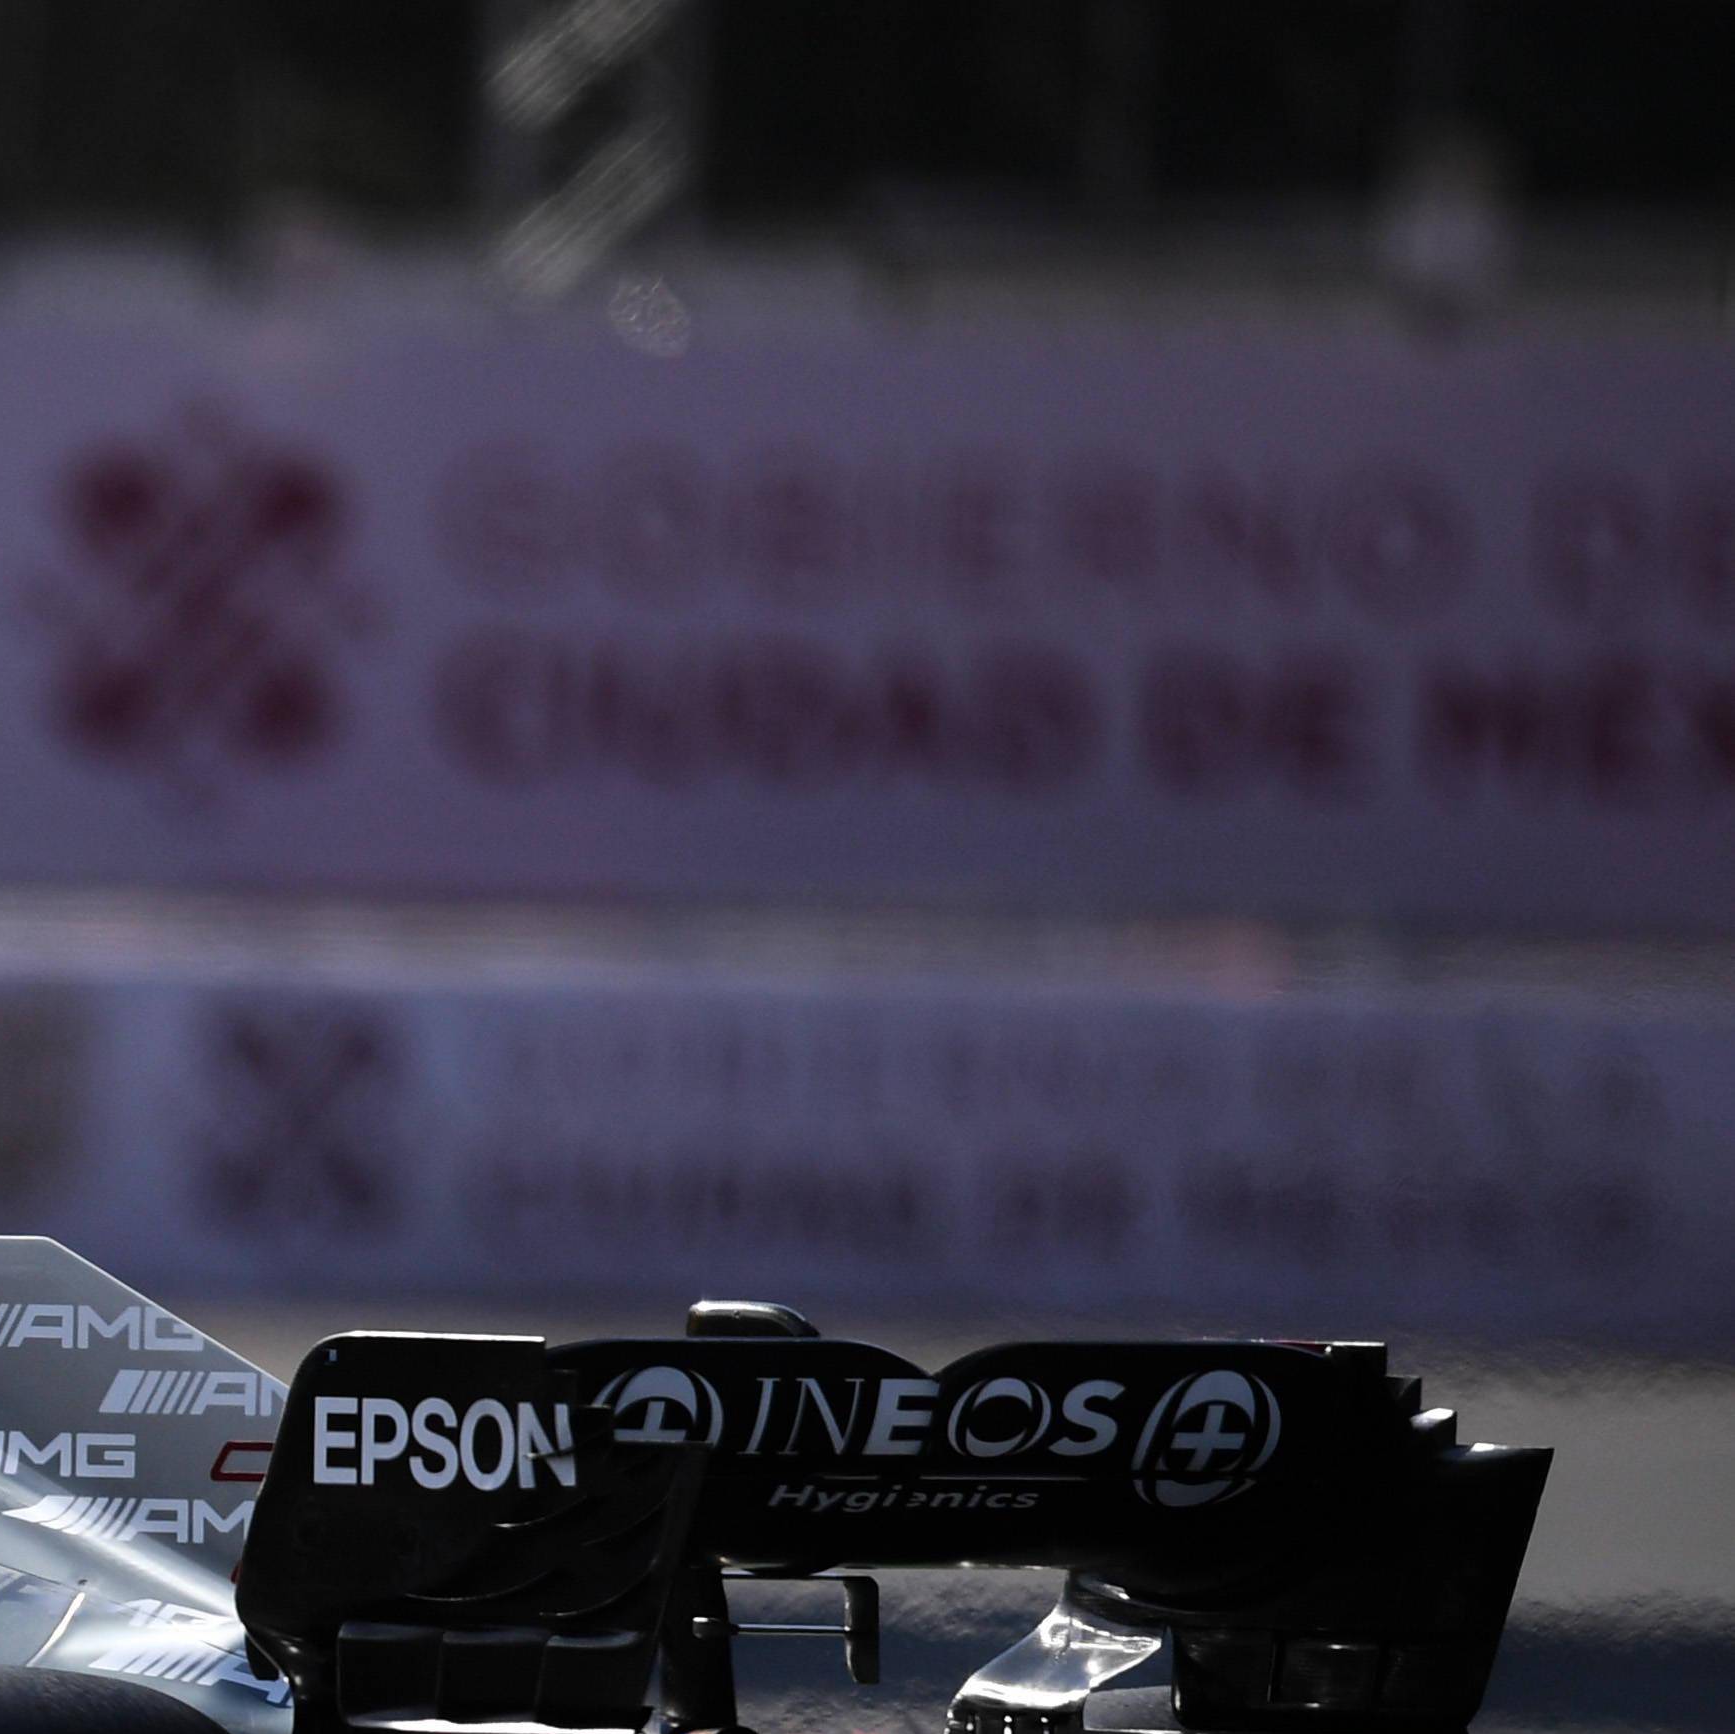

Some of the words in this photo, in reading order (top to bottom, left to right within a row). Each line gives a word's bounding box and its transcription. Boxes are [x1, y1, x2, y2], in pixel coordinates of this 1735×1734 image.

[10, 1304, 204, 1352] AMG
[312, 1395, 578, 1492] EPSON
[736, 1376, 1127, 1458] INEOS
[115, 1498, 256, 1544] AM
